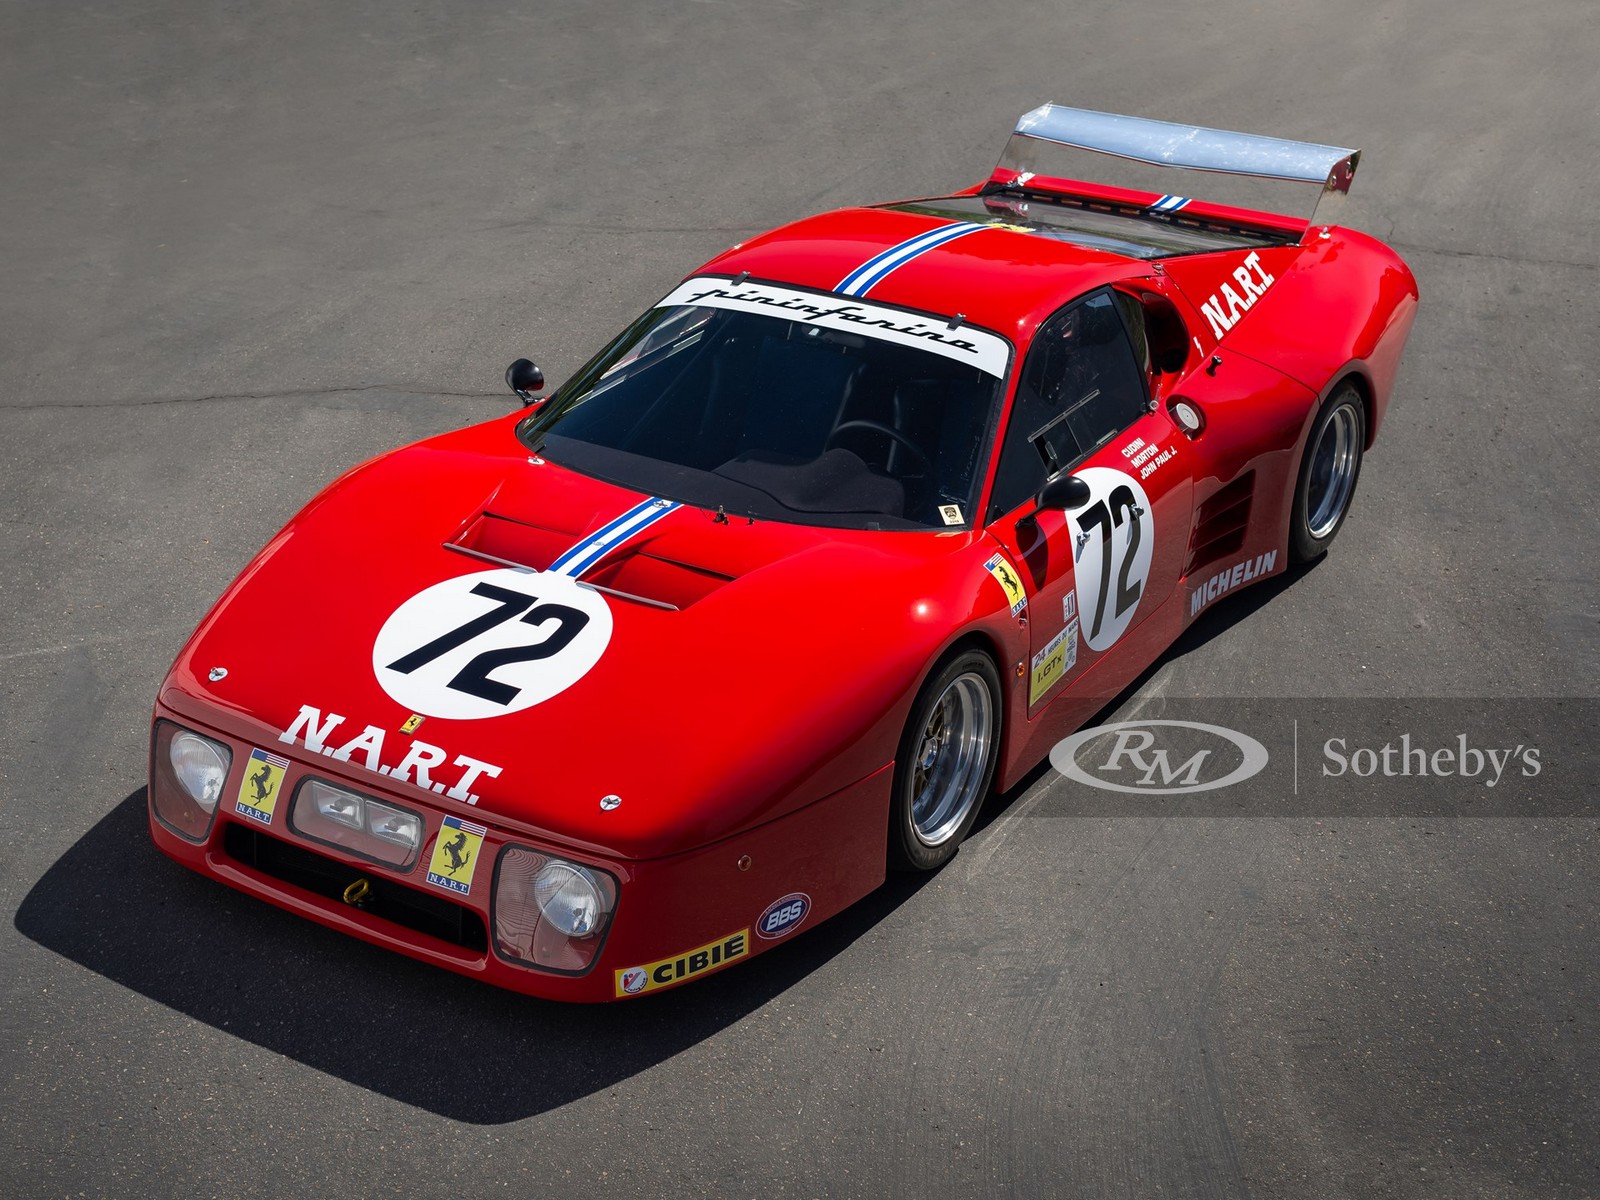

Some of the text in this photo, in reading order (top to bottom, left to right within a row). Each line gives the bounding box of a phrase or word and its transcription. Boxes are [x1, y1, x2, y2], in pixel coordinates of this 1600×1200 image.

[685, 288, 979, 354] pininfarina
[1121, 437, 1146, 458] CUDINI
[1130, 443, 1159, 469] MORTON
[1140, 460, 1157, 480] JOHN
[1154, 449, 1172, 467] PAUL
[1076, 485, 1142, 642] 72
[1190, 549, 1278, 617] MICHELIN
[386, 582, 590, 706] 72
[766, 900, 803, 931] BBS
